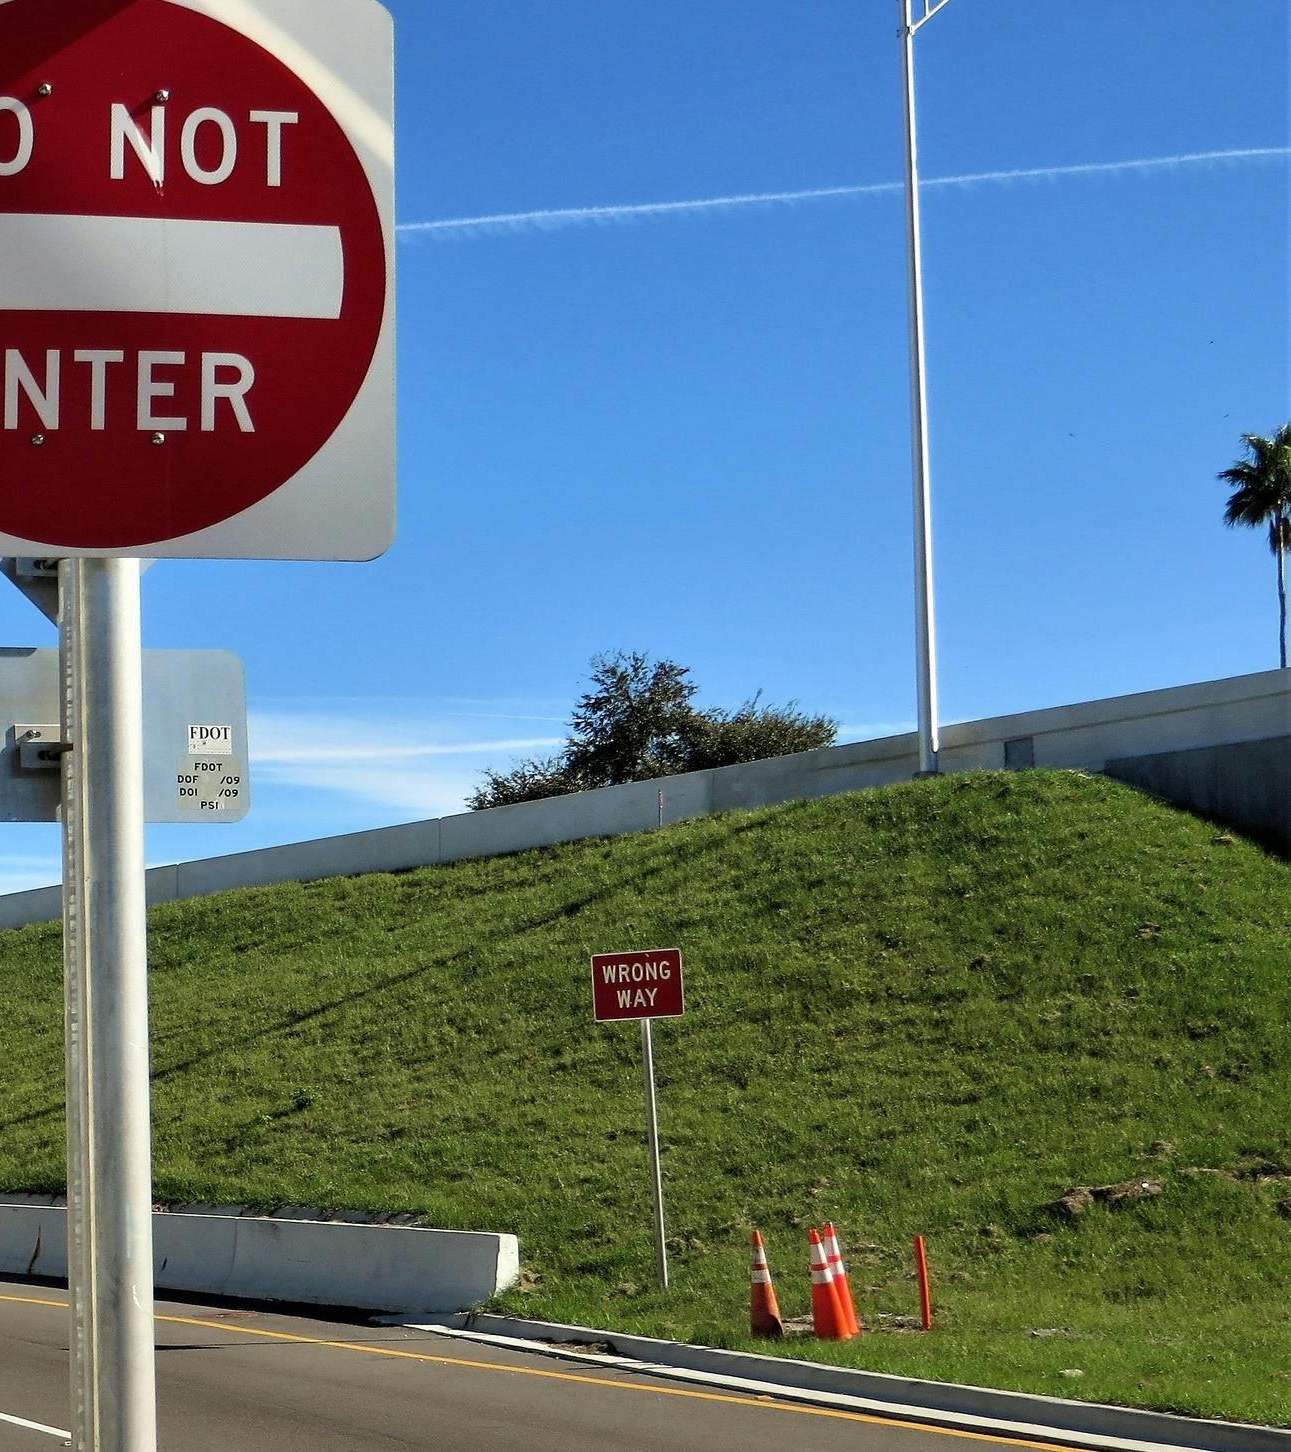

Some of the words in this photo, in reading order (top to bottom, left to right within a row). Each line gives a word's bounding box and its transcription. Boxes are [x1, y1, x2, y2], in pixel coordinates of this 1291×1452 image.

[110, 102, 299, 187] NOT
[190, 726, 230, 739] FDOT
[194, 763, 223, 771] FDOT
[177, 775, 199, 784] DOF
[220, 776, 240, 785] /09
[179, 788, 198, 796] DOI
[218, 788, 239, 798] /09
[602, 960, 671, 984] WRONG
[616, 987, 658, 1009] WAY
